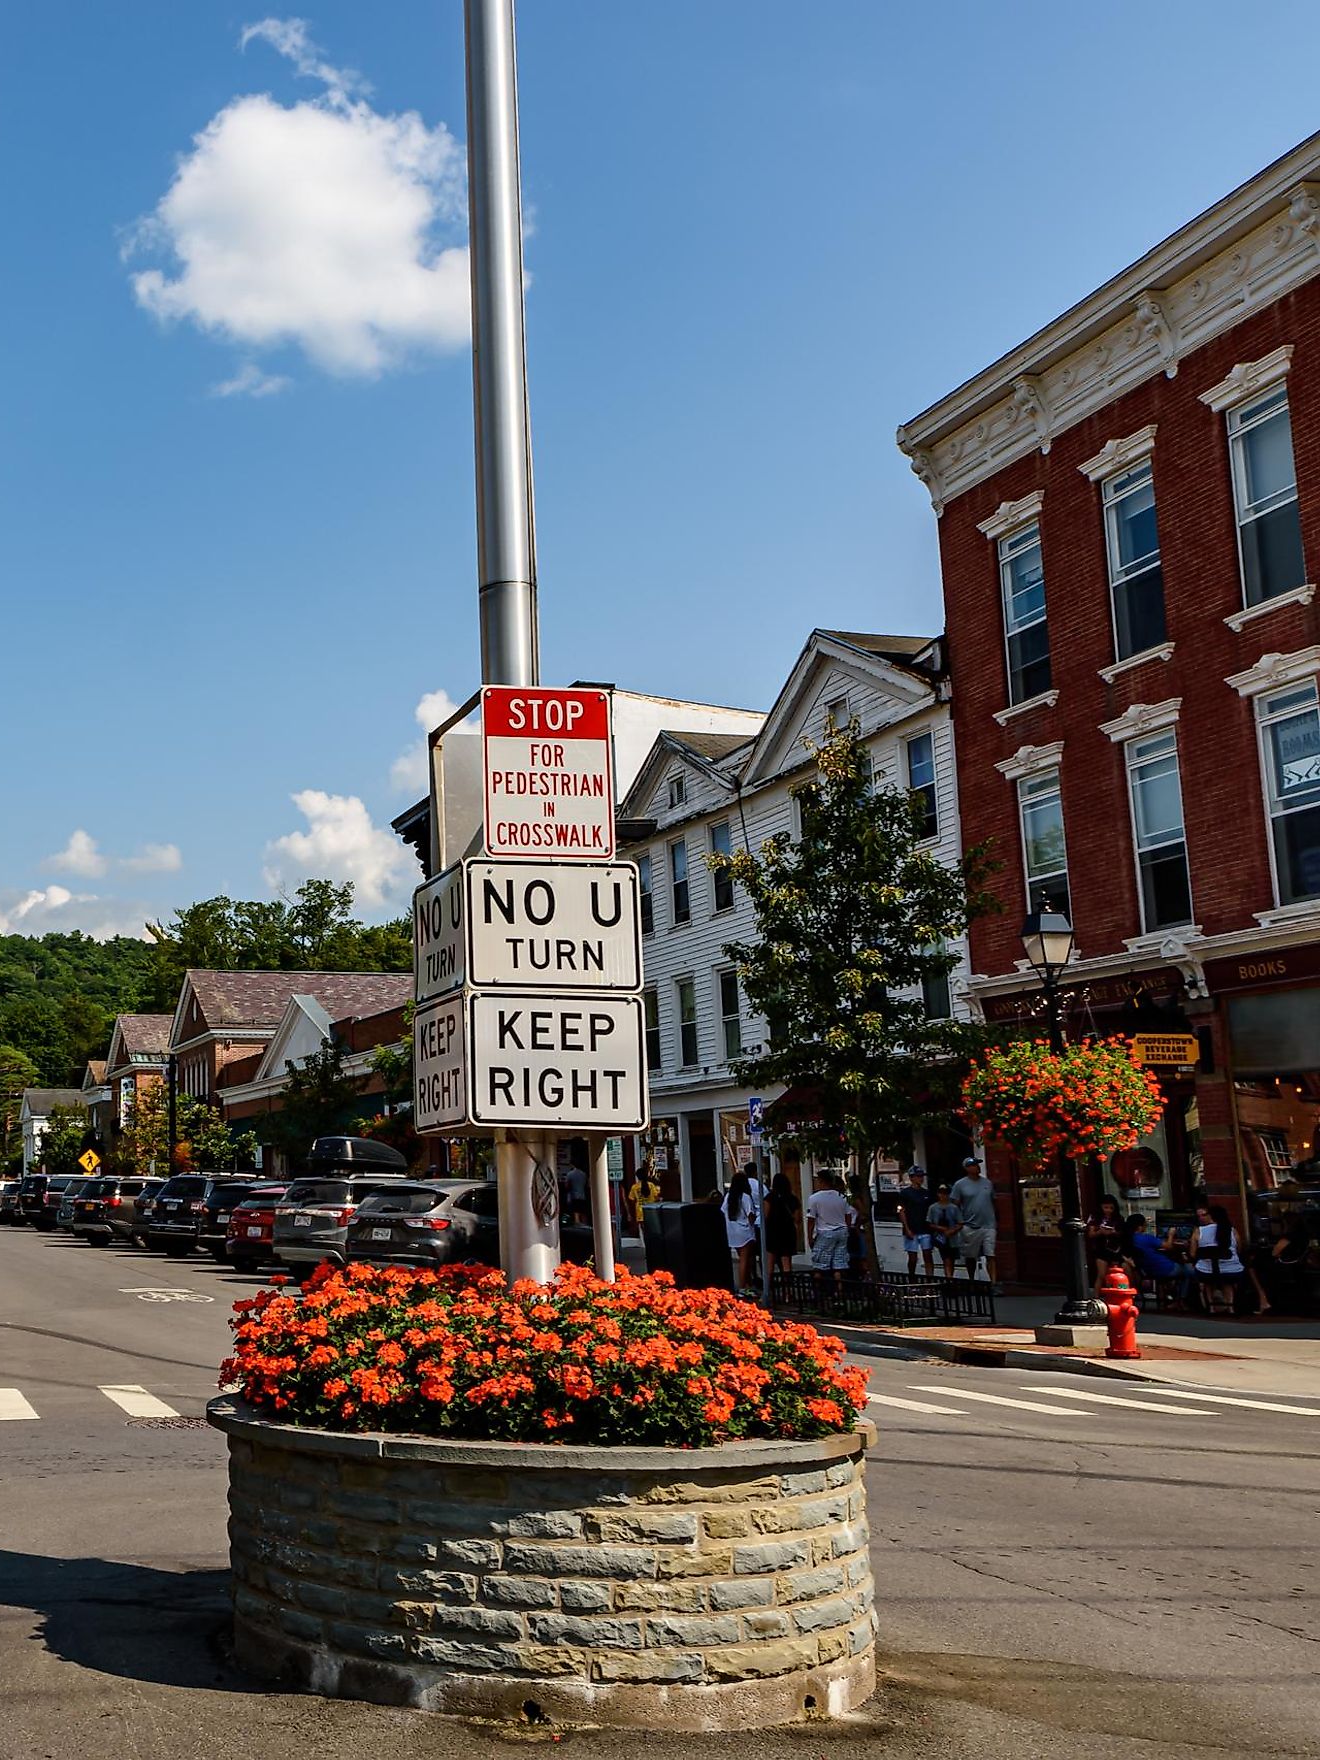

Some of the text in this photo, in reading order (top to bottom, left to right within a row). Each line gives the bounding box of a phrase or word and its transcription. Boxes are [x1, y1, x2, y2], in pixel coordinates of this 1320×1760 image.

[508, 698, 584, 731] STOP
[529, 743, 564, 767] FOR
[492, 771, 604, 797] PEDESTRIAN
[543, 802, 555, 818] IN
[496, 822, 603, 848] CROSSWALK
[419, 881, 461, 947] NO U
[483, 878, 622, 928] NO U
[425, 943, 456, 985] TURN
[505, 937, 604, 971] TURN
[1238, 960, 1287, 980] BOOKS
[420, 1013, 456, 1062] KEEP
[498, 1009, 616, 1052] KEEP
[1137, 1037, 1193, 1045] COOPERSTOWN
[1145, 1045, 1187, 1053] BEVERAGE
[1145, 1053, 1188, 1061] EXCHANGE
[418, 1067, 461, 1116] RIGHT
[488, 1066, 627, 1110] RIGHT
